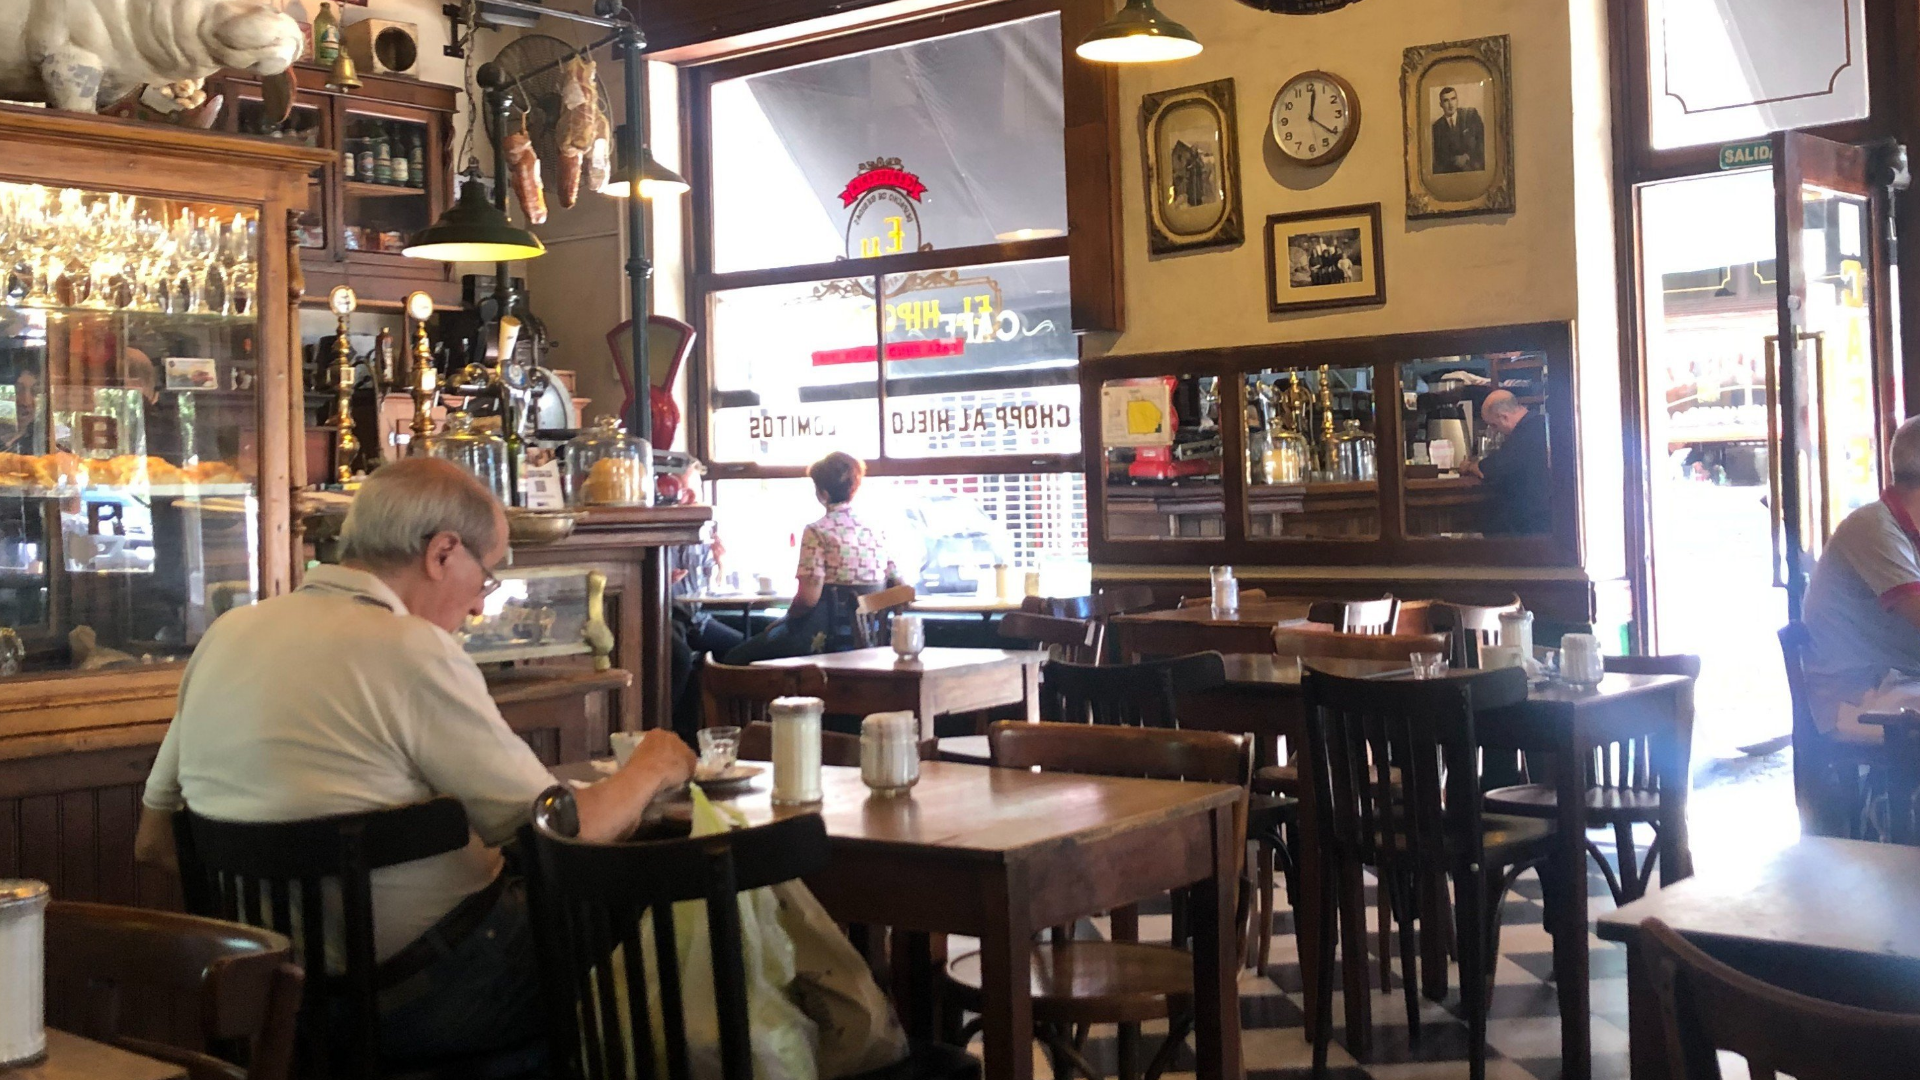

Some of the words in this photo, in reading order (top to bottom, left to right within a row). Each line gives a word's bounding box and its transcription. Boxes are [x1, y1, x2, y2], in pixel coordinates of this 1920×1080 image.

[1294, 88, 1302, 98] 11
[1330, 95, 1338, 104] 2
[1285, 102, 1293, 111] 10
[1334, 109, 1342, 118] 3
[1281, 117, 1288, 126] 9
[1285, 132, 1292, 140] 8
[1294, 141, 1302, 150] 7
[1322, 138, 1330, 147] 5
[1308, 144, 1316, 152] 6
[1725, 145, 1773, 164] SALID
